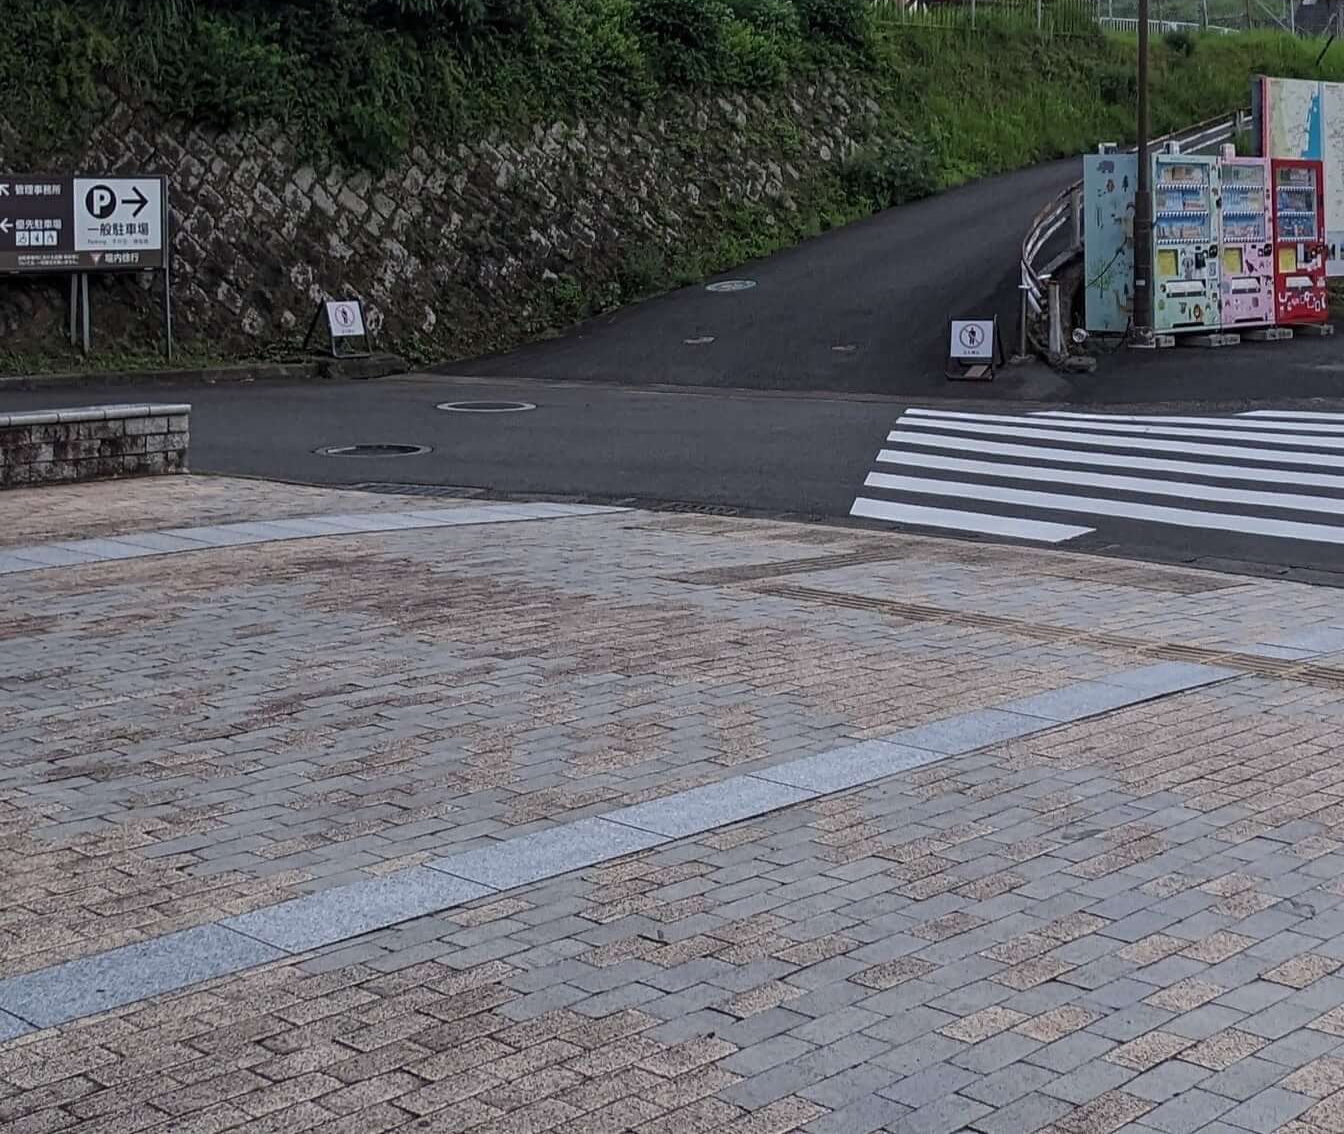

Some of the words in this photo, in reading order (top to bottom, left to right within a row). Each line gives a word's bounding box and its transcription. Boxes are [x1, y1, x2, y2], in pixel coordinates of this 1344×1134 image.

[15, 184, 61, 195] 管理事務所
[87, 222, 149, 236] 一般駐車場
